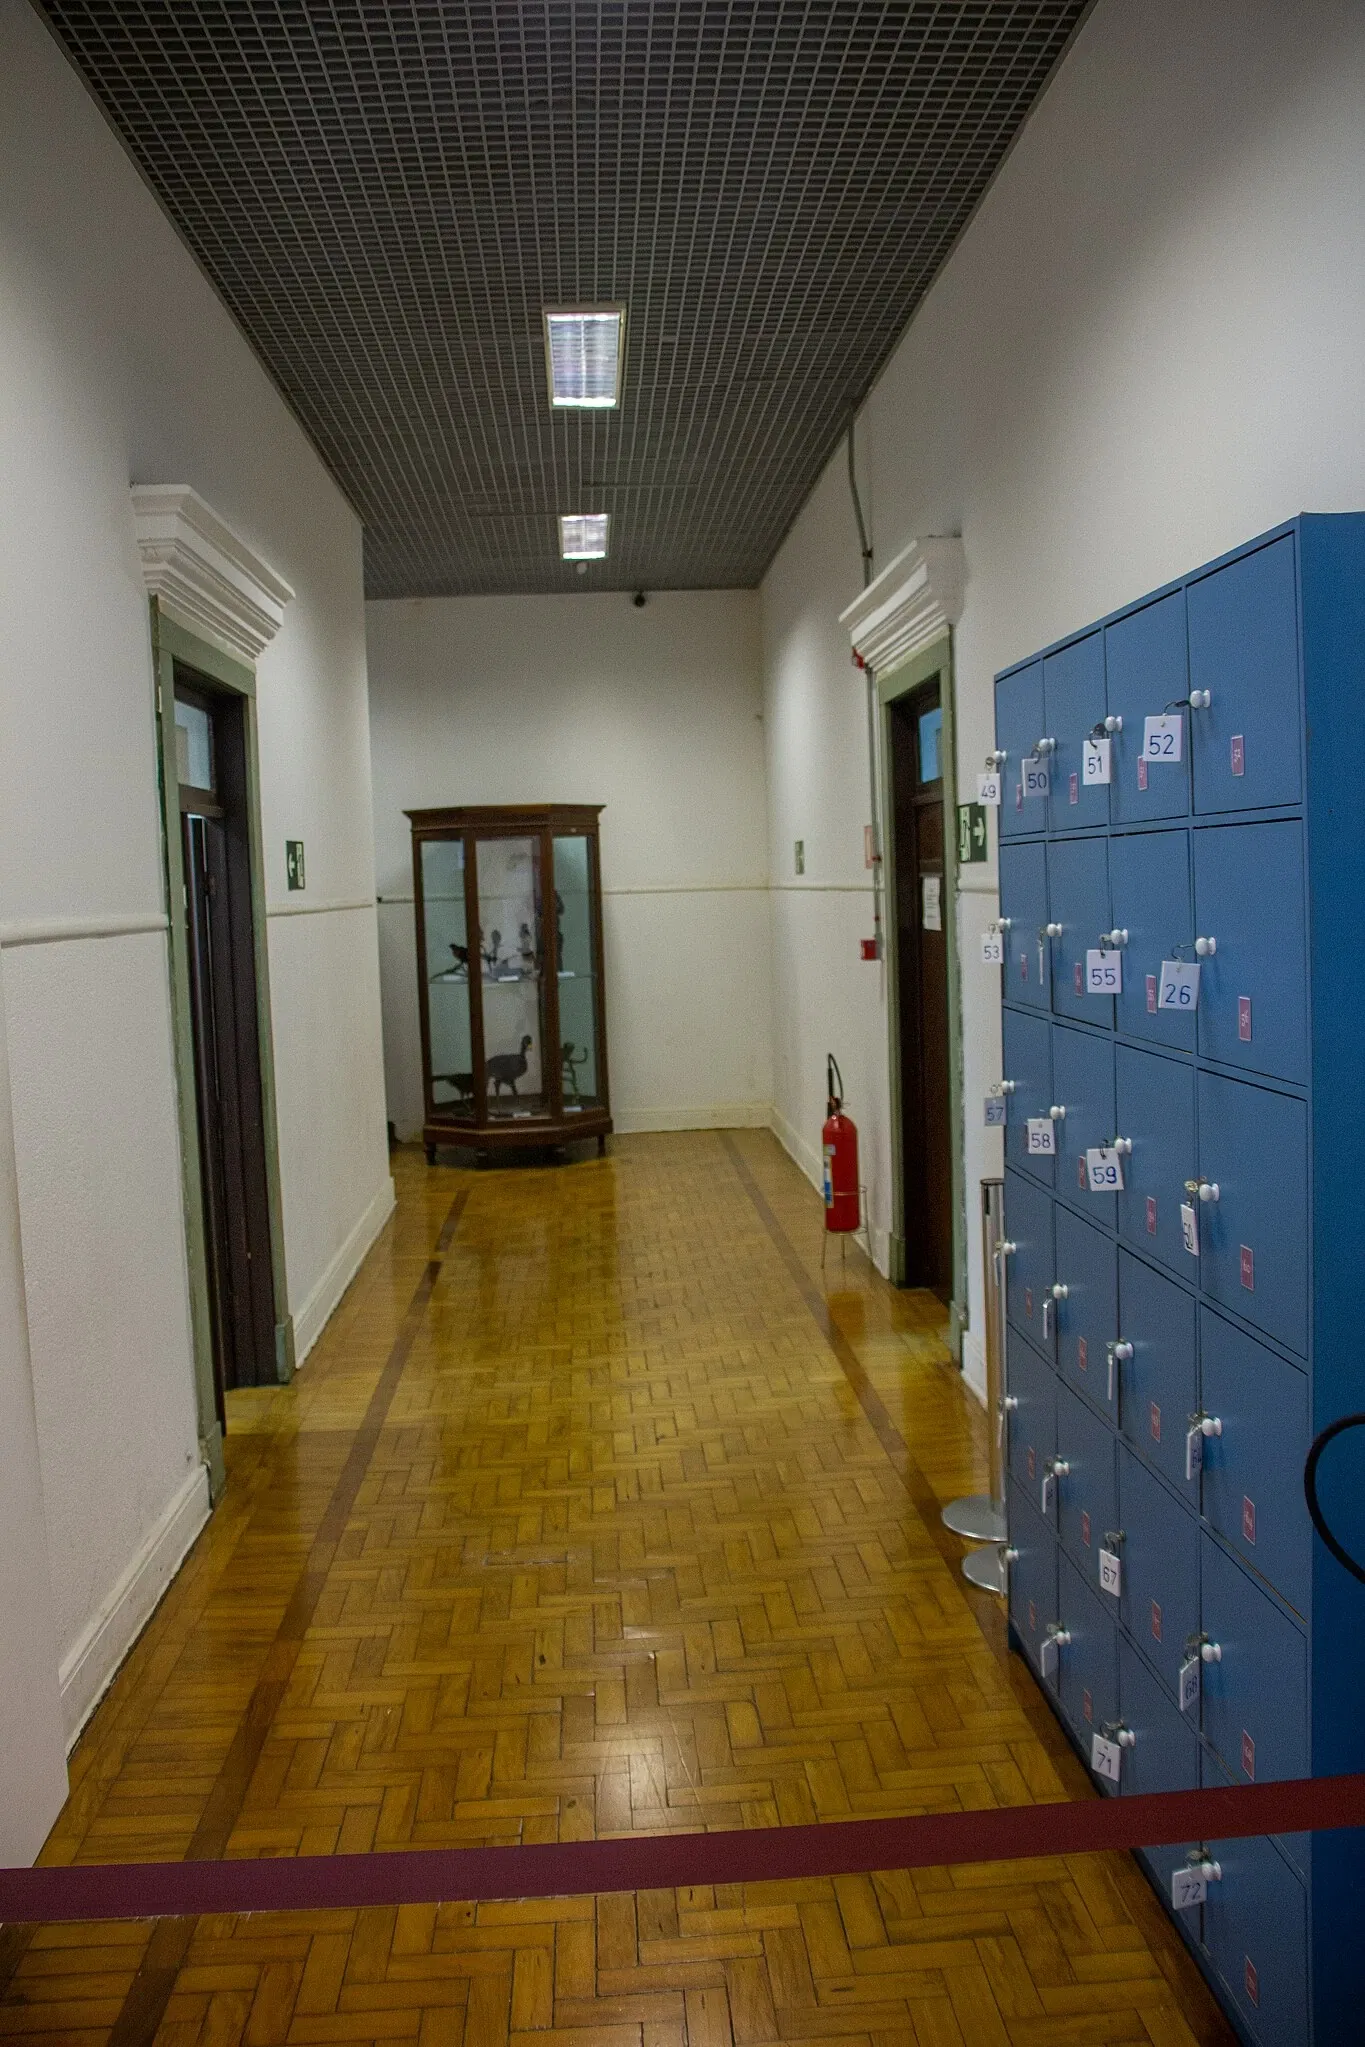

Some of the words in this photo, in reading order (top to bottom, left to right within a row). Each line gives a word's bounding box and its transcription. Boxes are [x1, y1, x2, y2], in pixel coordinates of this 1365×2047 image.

[1148, 734, 1175, 756] 52
[1087, 757, 1104, 775] 51
[1028, 773, 1047, 789] 50
[980, 784, 997, 799] 49
[984, 947, 999, 960] 53
[1091, 968, 1117, 987] 55
[1165, 983, 1192, 1006] 26
[987, 1107, 1004, 1121] 57
[1031, 1133, 1051, 1149] 58
[1092, 1166, 1117, 1185] 59
[1102, 1565, 1118, 1585] 67
[1098, 1751, 1113, 1775] 71
[1180, 1882, 1202, 1904] 72
